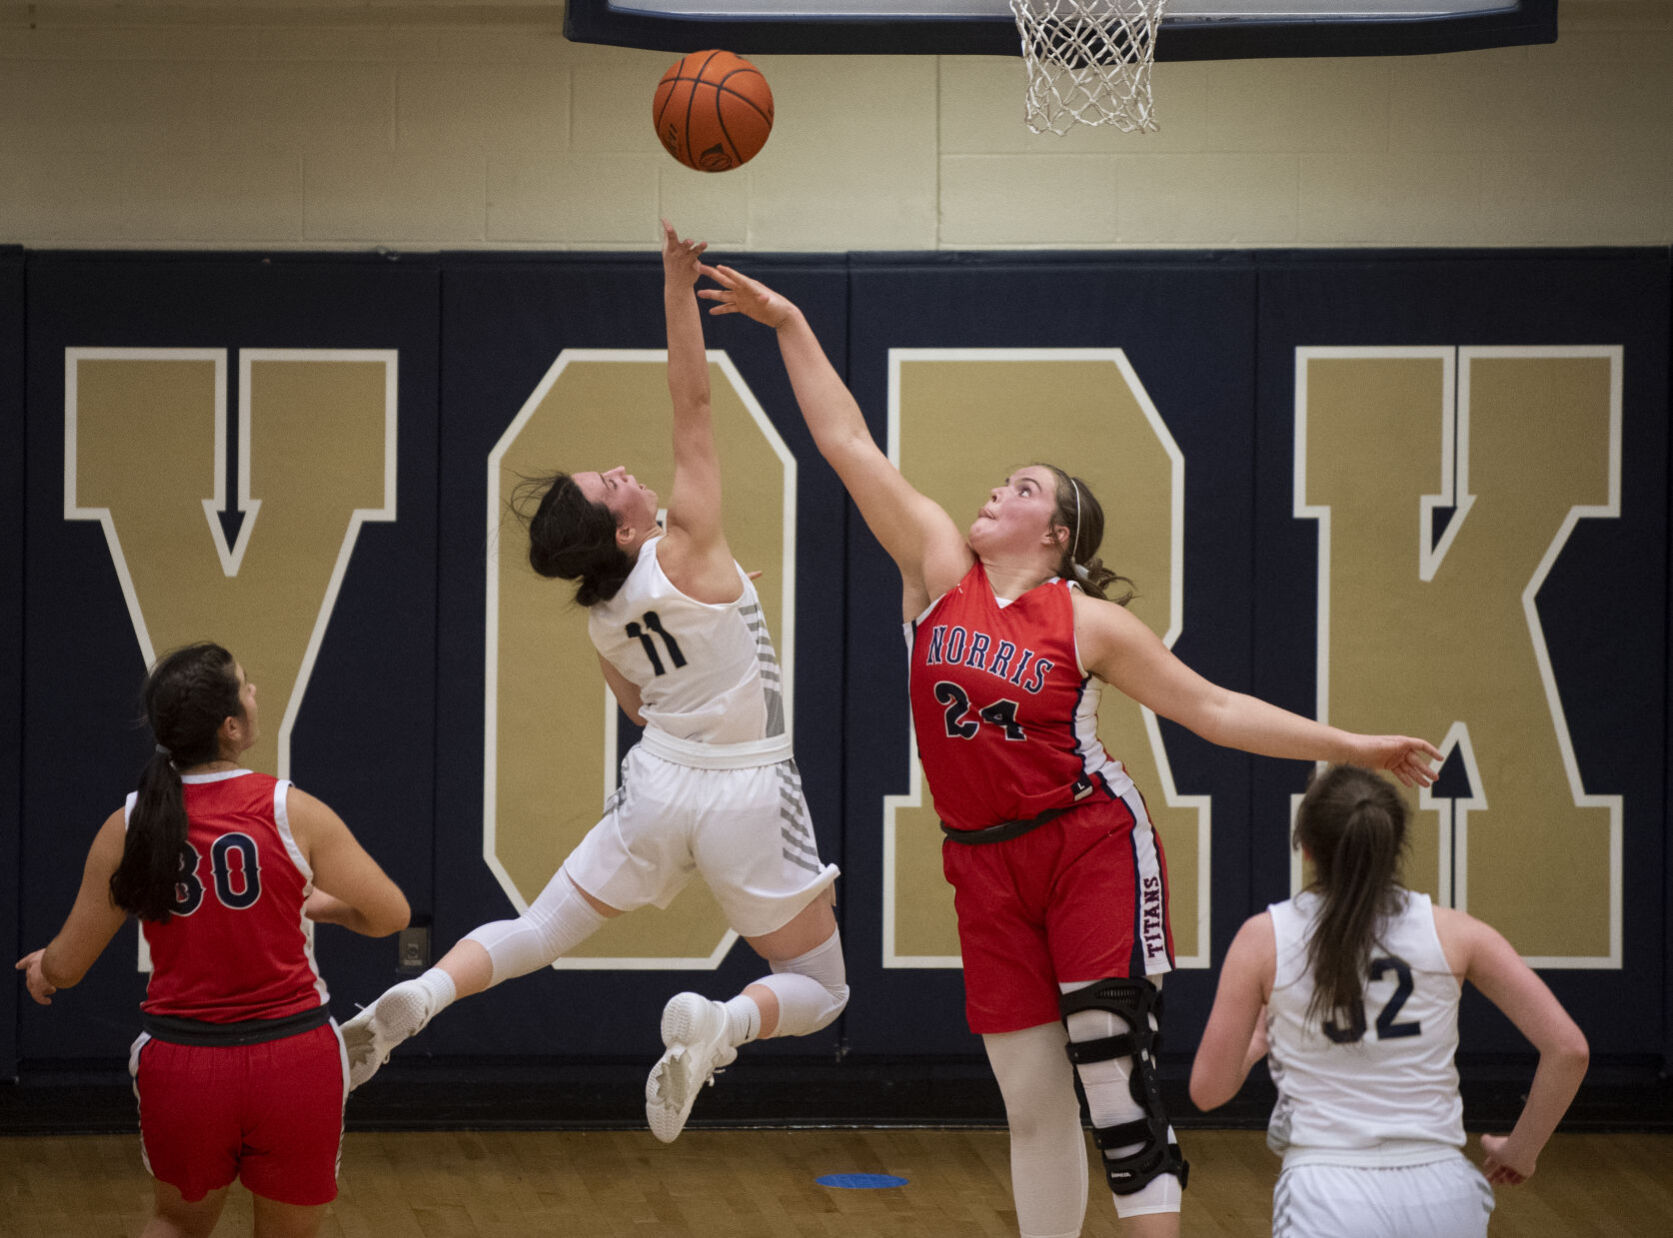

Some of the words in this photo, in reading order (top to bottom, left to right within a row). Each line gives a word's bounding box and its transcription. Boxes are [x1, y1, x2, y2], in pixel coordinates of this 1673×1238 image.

[64, 345, 1624, 970] YORK
[624, 610, 688, 677] 11
[925, 624, 1055, 695] NORRIS
[933, 680, 1028, 742] 24
[1143, 876, 1165, 958] TITANS
